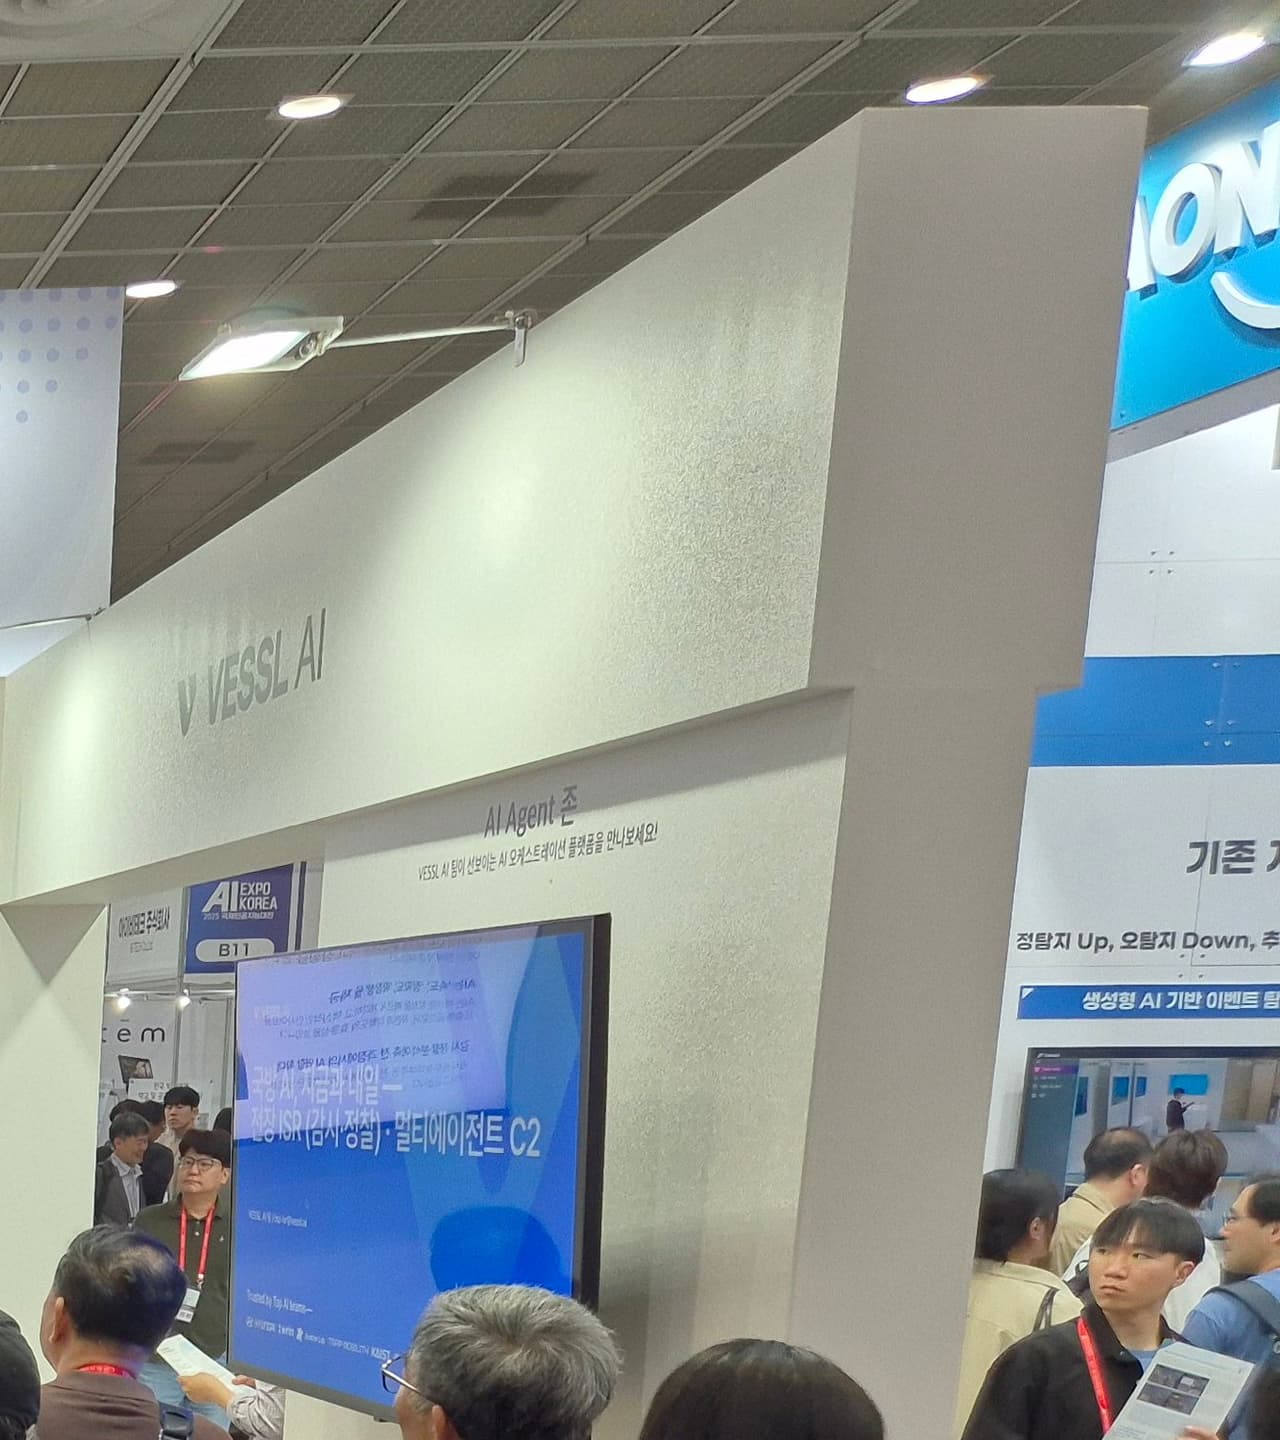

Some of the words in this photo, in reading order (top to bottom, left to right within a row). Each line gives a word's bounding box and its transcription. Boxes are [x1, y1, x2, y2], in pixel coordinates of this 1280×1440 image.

[208, 630, 288, 725] VESSL
[294, 607, 326, 690] AI
[484, 806, 501, 838] AI
[505, 795, 554, 838] Agent
[560, 785, 577, 827] 존
[1186, 840, 1256, 875] 기존
[202, 881, 239, 913] AI
[240, 882, 271, 896] EXPO
[239, 896, 278, 911] KOREA
[219, 943, 249, 957] B11
[1016, 932, 1072, 951] 정탐지
[1077, 932, 1115, 954] Up,
[1119, 931, 1176, 951] 오탐지
[1182, 932, 1256, 952] Down,
[1082, 991, 1136, 1011] 생성형
[1138, 993, 1162, 1009] AI
[1166, 991, 1203, 1010] 기반
[1206, 990, 1259, 1010] 이벤트
[395, 1109, 505, 1157] 멀티에이전트
[510, 1116, 541, 1157] C2
